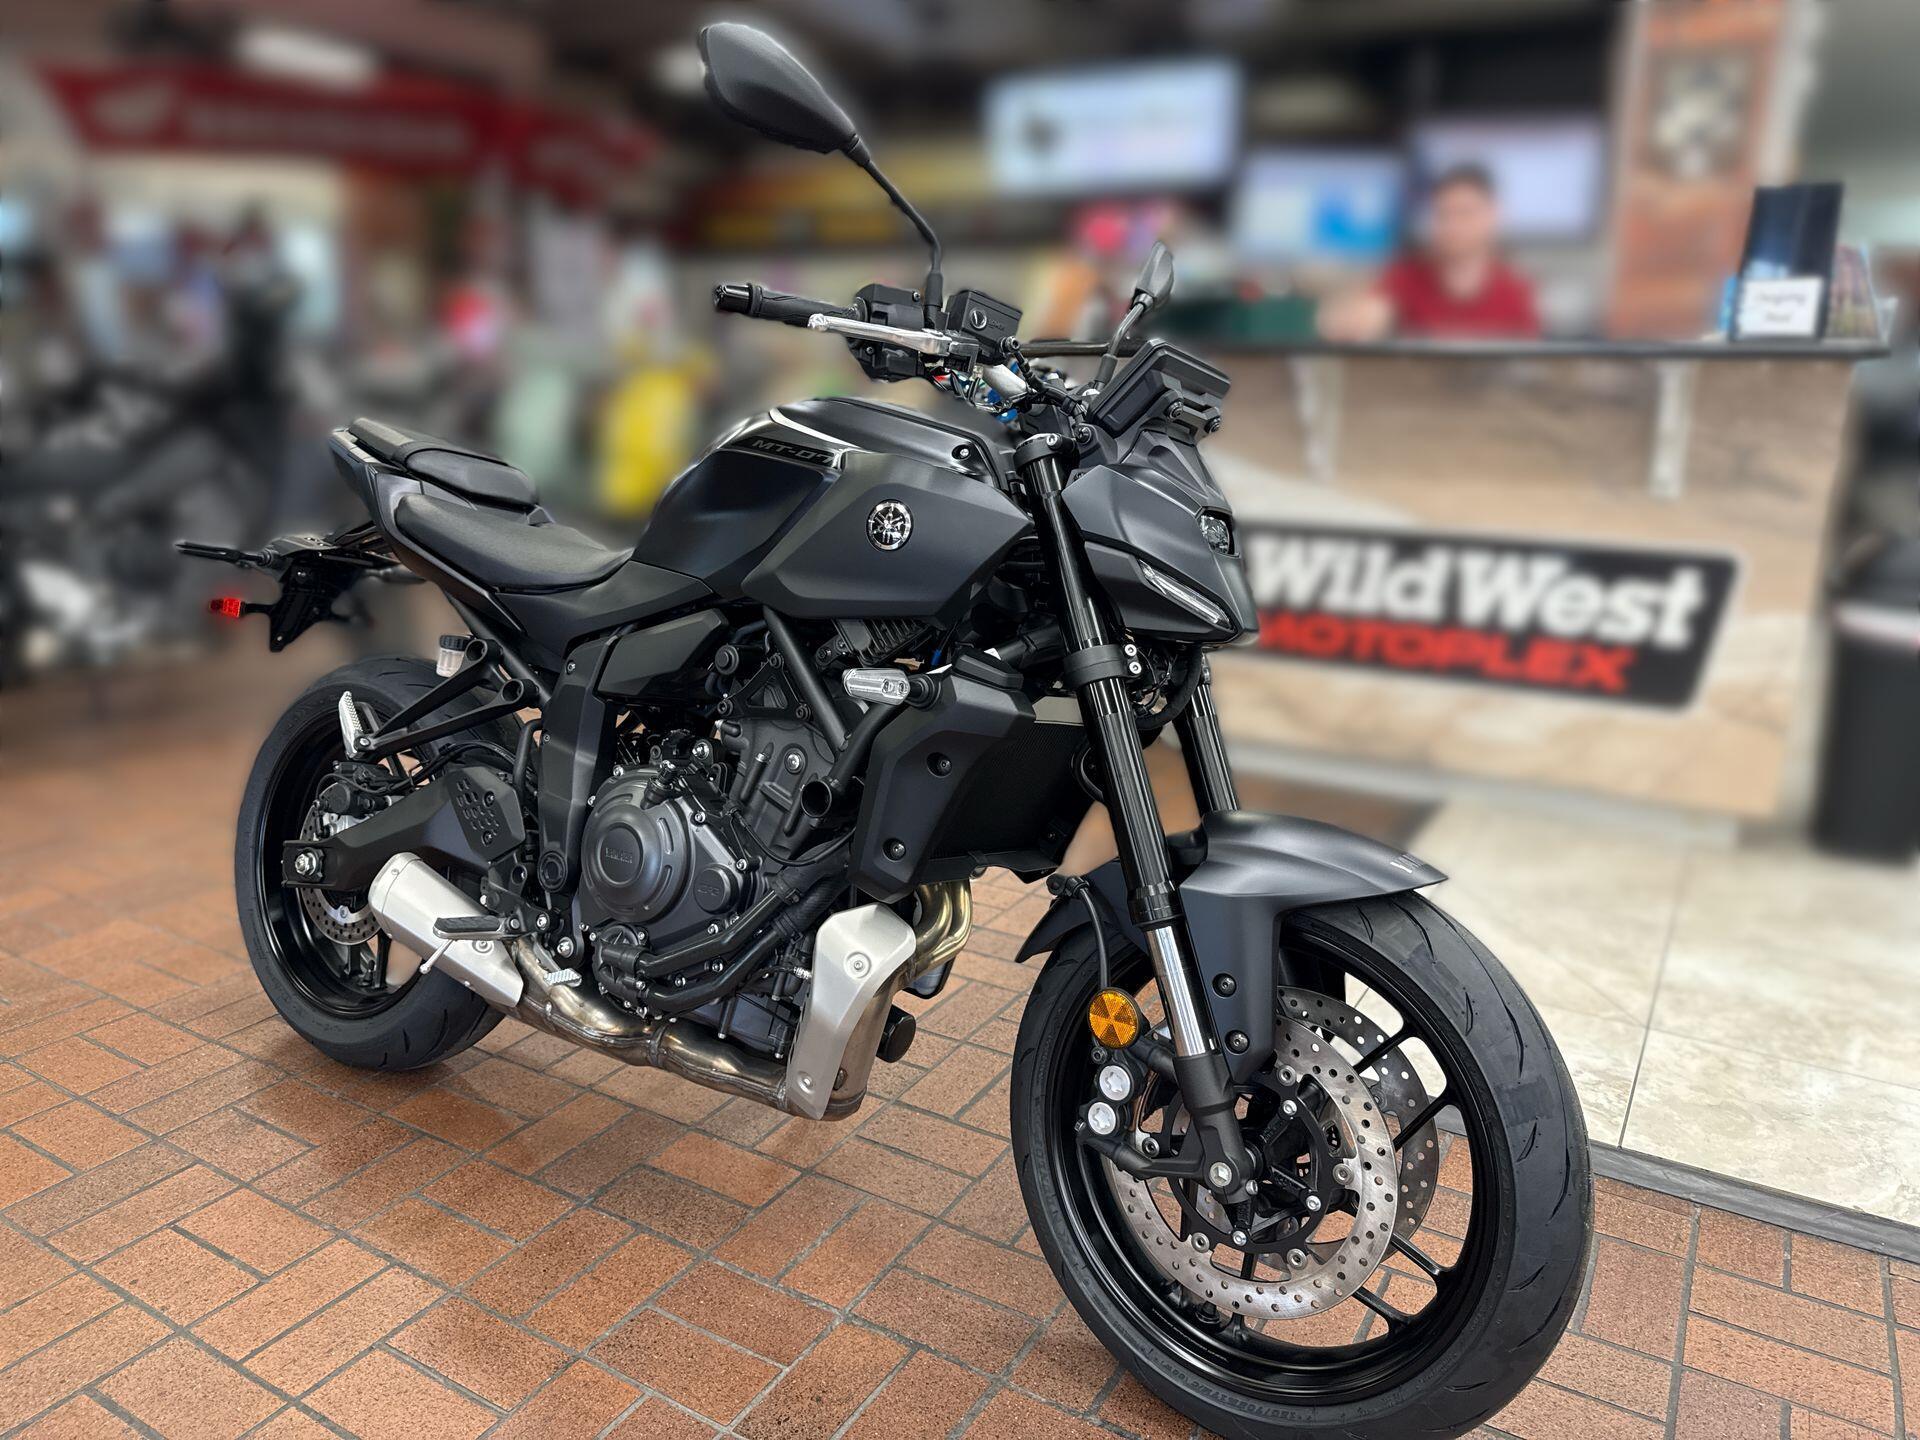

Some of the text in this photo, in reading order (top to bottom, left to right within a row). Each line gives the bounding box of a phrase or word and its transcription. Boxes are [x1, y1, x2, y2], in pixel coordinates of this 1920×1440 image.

[752, 440, 834, 463] MT-07
[1249, 533, 1704, 651] Wild West
[1258, 608, 1636, 695] MOTOPLEX
